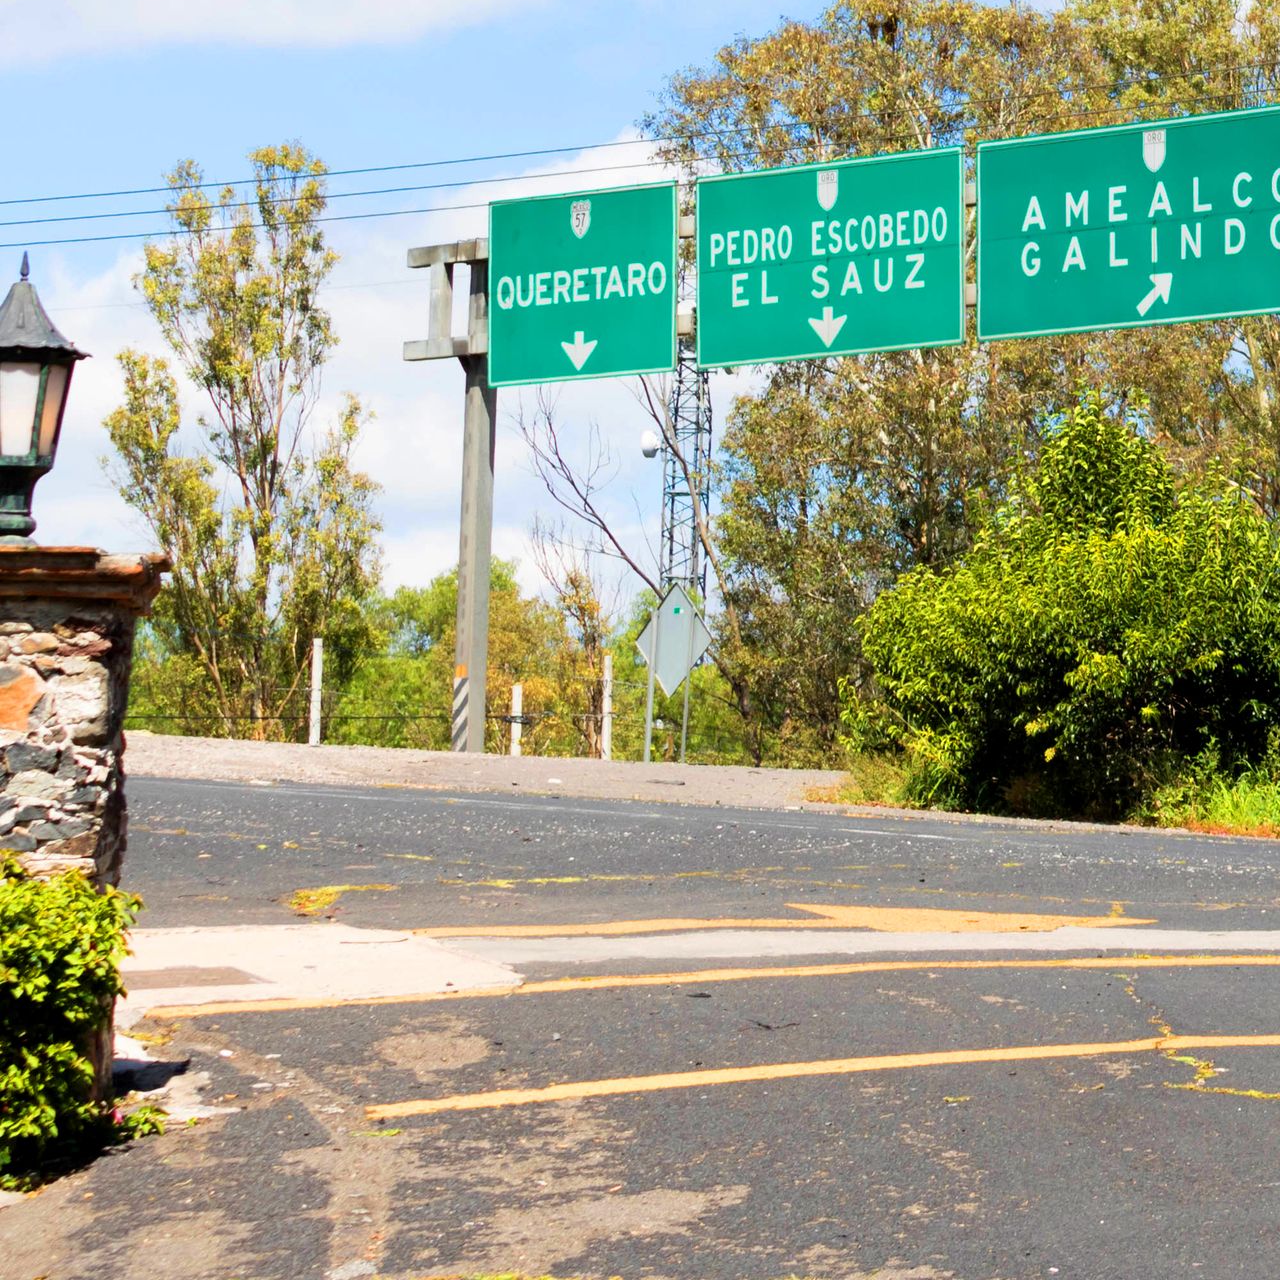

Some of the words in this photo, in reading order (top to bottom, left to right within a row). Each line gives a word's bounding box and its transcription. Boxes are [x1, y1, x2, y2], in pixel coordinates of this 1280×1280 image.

[575, 212, 586, 228] 57
[710, 224, 793, 268] PEDRO
[811, 206, 948, 256] ESCOBEDO
[496, 261, 667, 310] QUERETARO
[732, 270, 779, 308] EL
[811, 253, 926, 300] SAUZ
